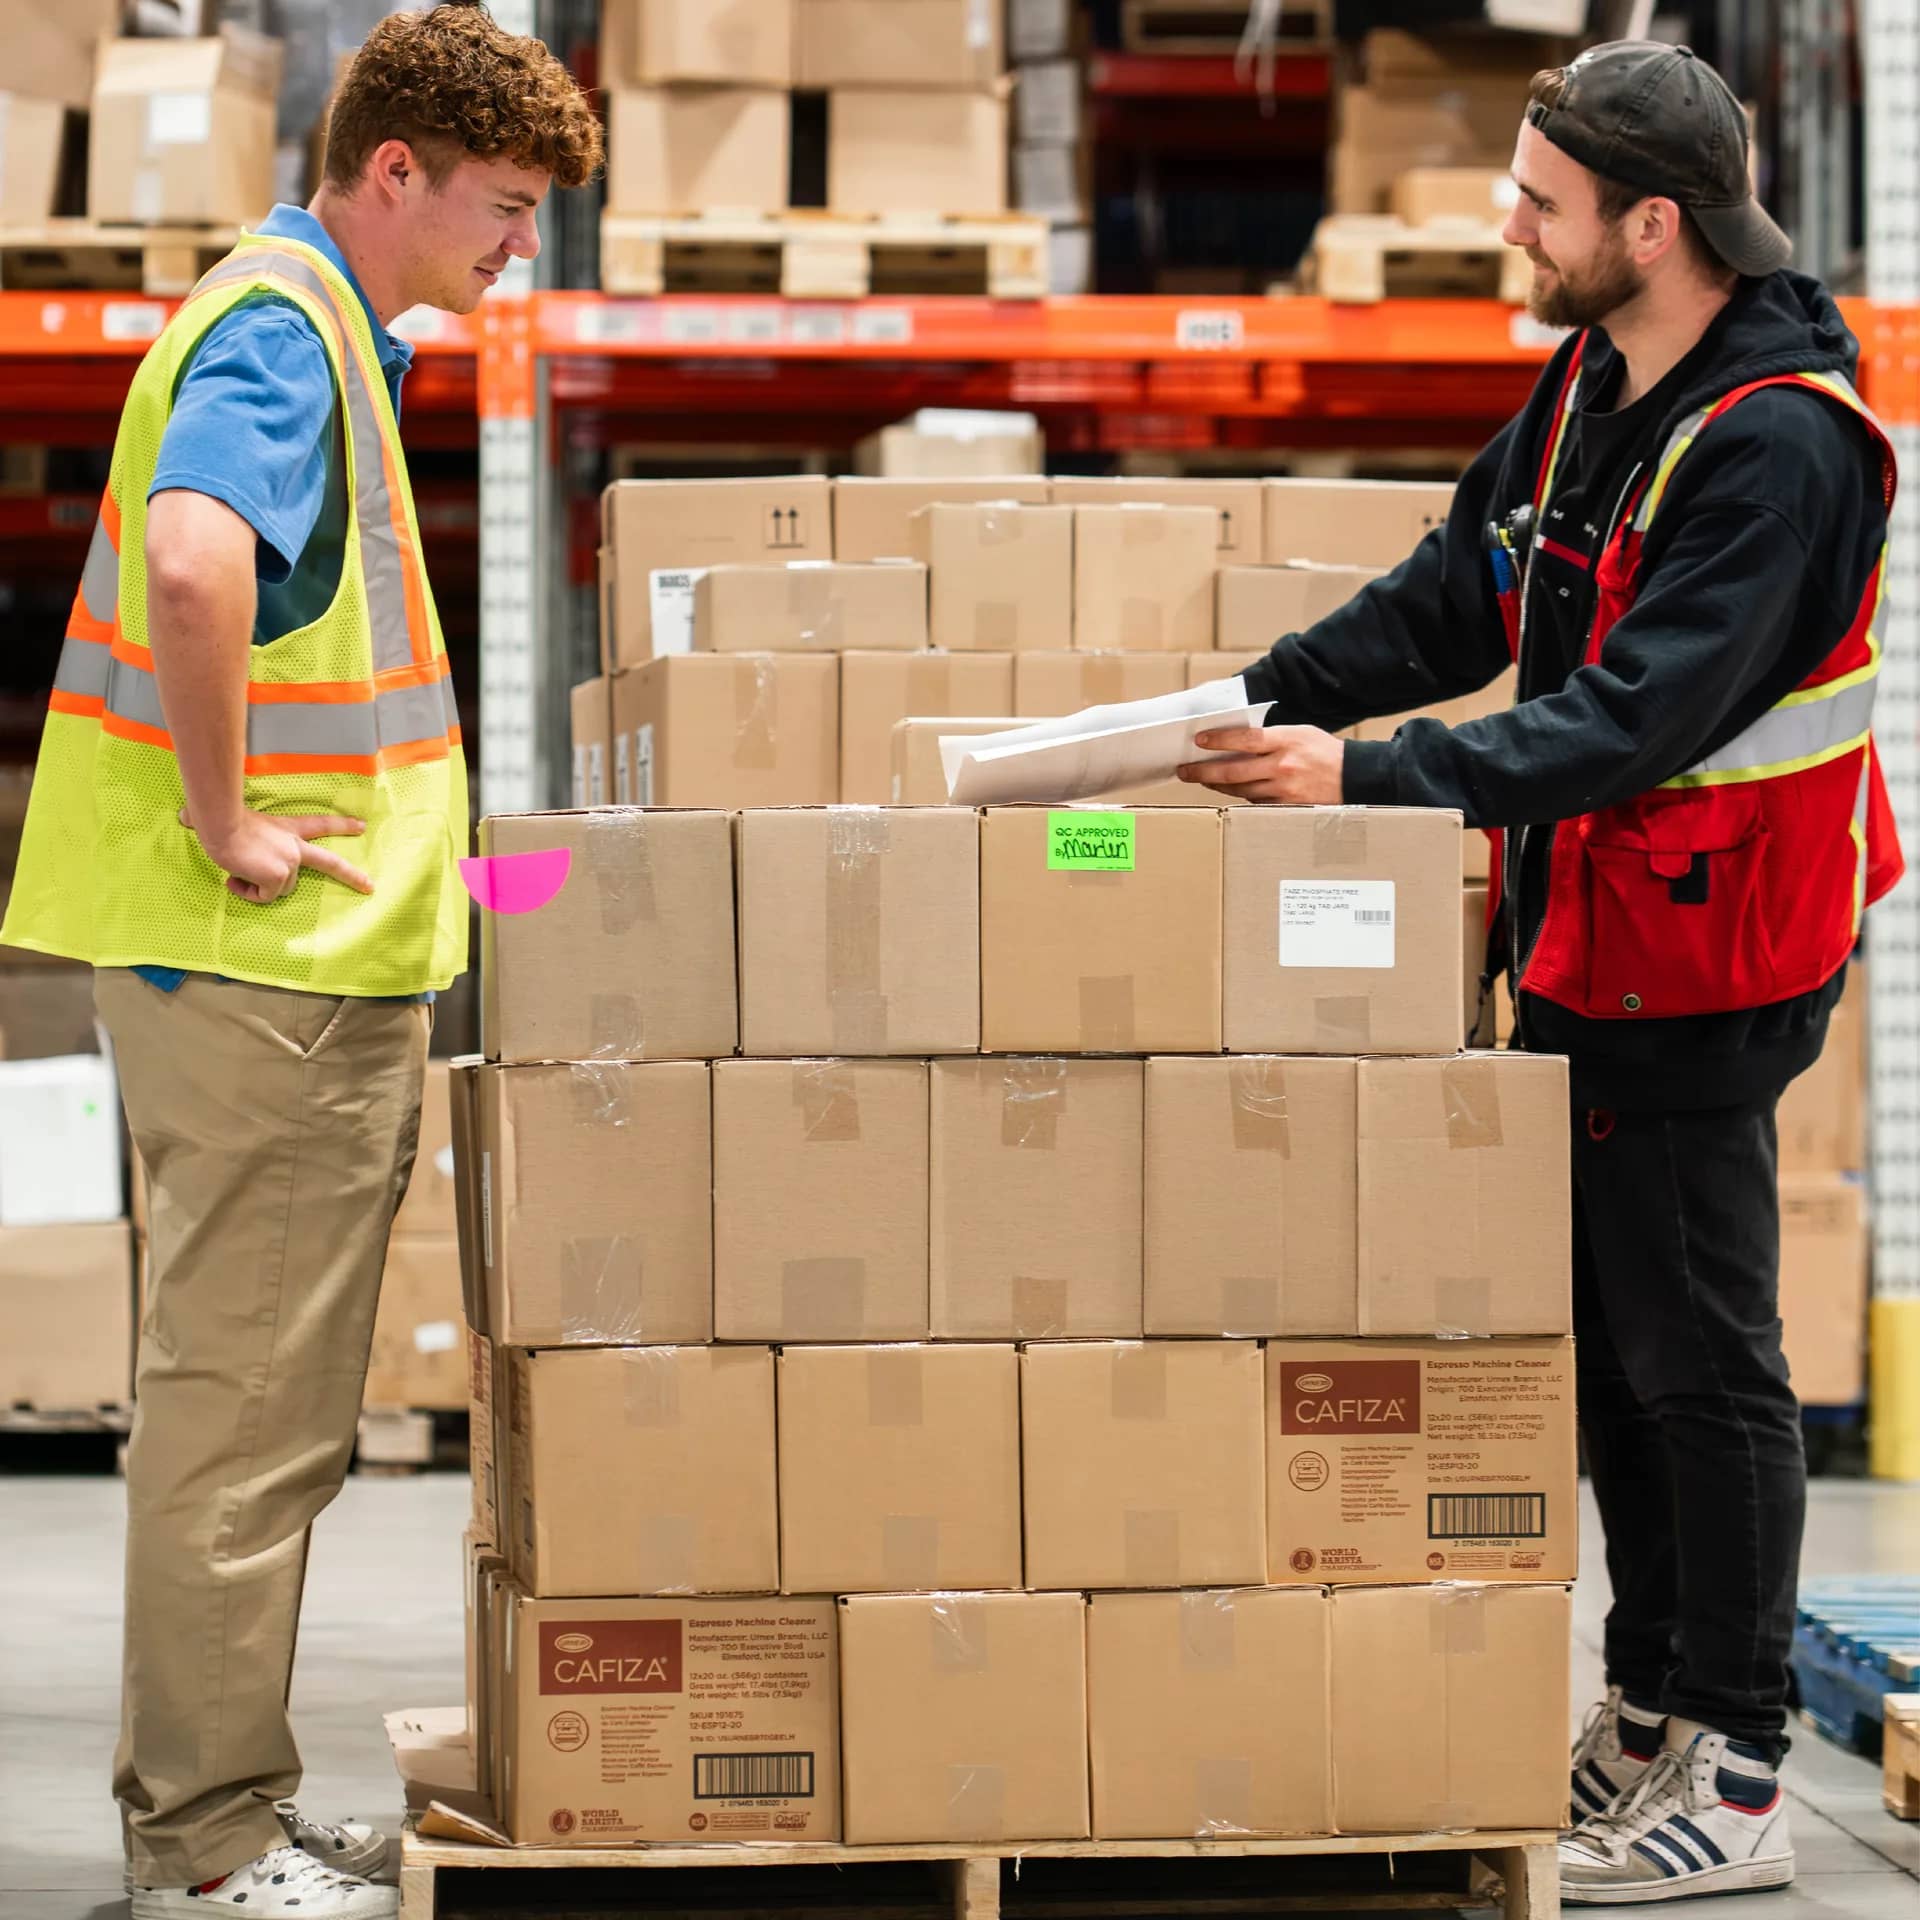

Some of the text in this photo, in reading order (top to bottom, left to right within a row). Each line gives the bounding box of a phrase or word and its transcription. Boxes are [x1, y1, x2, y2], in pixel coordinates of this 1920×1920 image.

[1055, 827, 1129, 838] QC APPROVED
[1427, 1359, 1552, 1370] Espresso Machine Cleaner
[1476, 1385, 1518, 1393] Executive
[1320, 1548, 1358, 1556] WORLD
[1320, 1556, 1363, 1564] BARISTA
[688, 1617, 816, 1629] Espresso Machine Cleaner
[811, 1632, 829, 1640] LLC
[740, 1642, 782, 1651] Executive
[763, 1671, 808, 1679] containers
[689, 1682, 714, 1690] Gross
[689, 1711, 714, 1719] SKU#
[580, 1809, 619, 1817] WORLD
